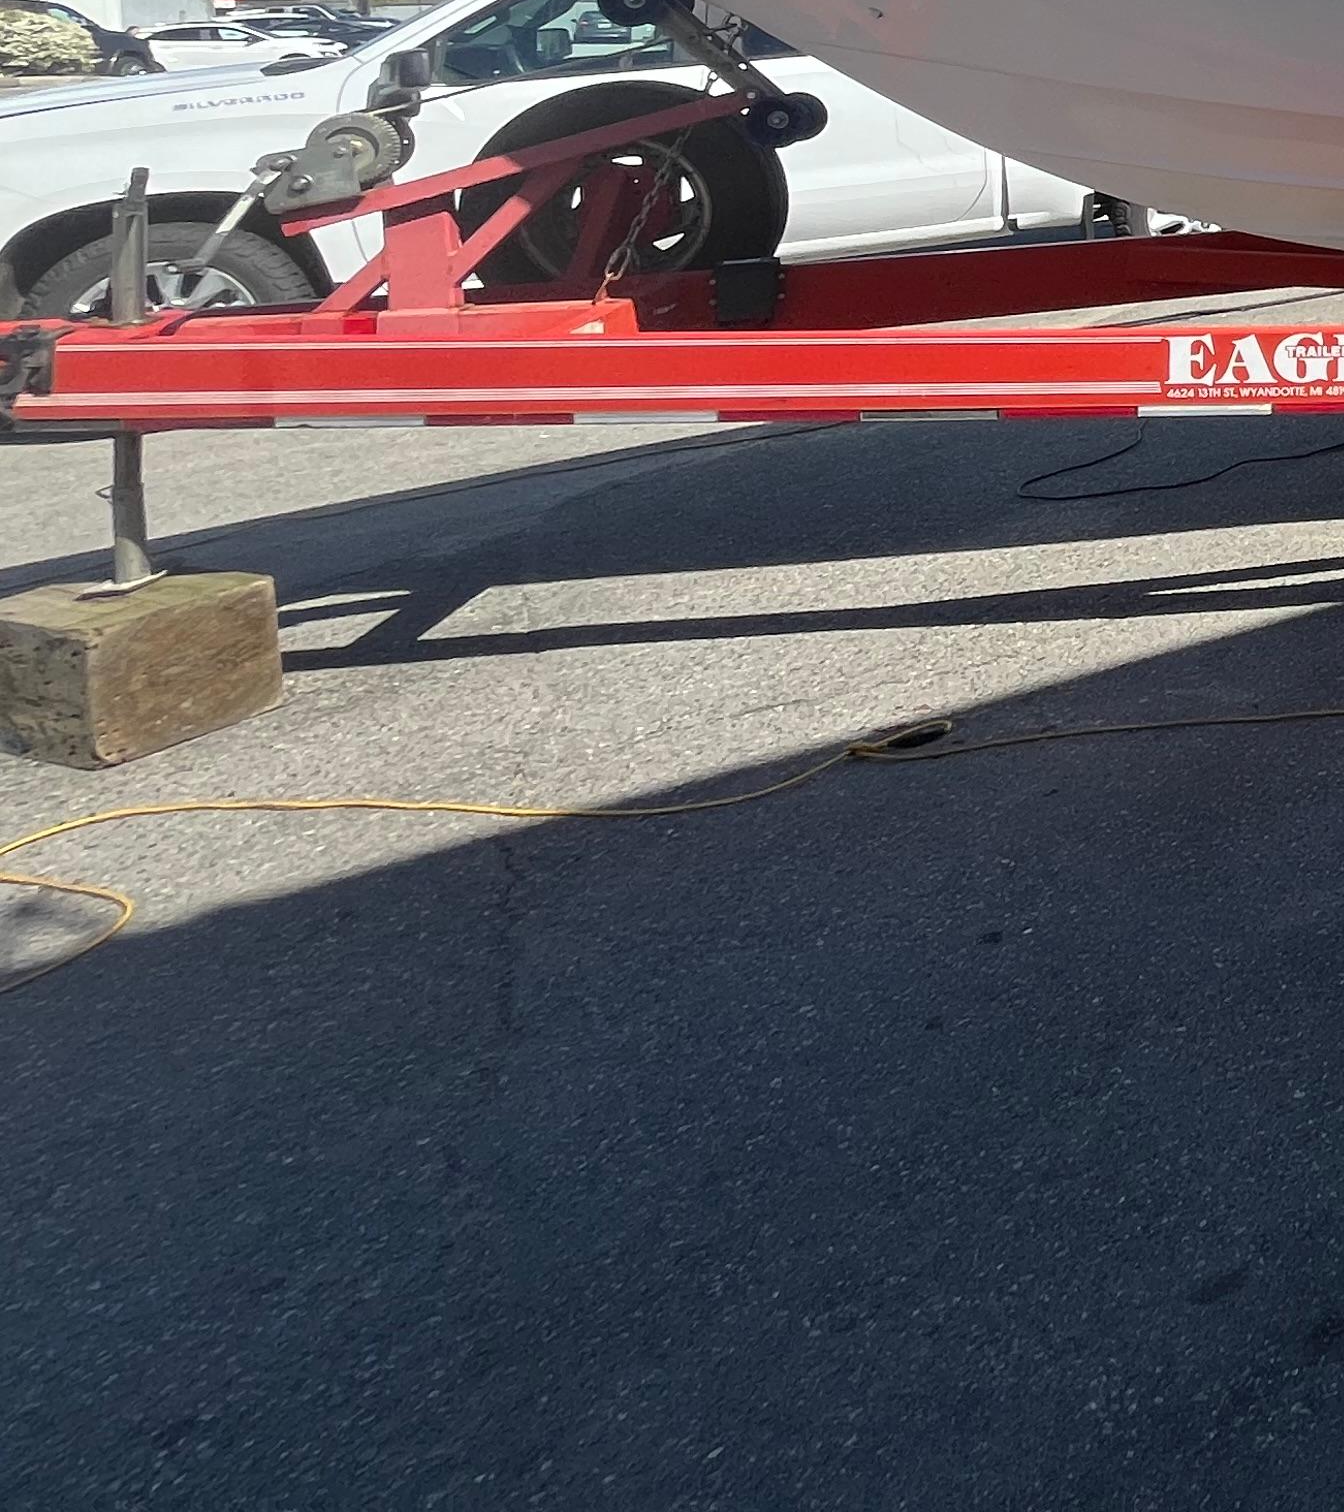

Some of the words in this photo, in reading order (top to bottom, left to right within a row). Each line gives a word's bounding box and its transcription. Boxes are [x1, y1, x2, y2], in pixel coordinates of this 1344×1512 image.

[173, 92, 305, 111] SILVERADO
[1166, 388, 1195, 398] 4624
[1198, 387, 1221, 398] 13TH
[1309, 386, 1323, 396] MI
